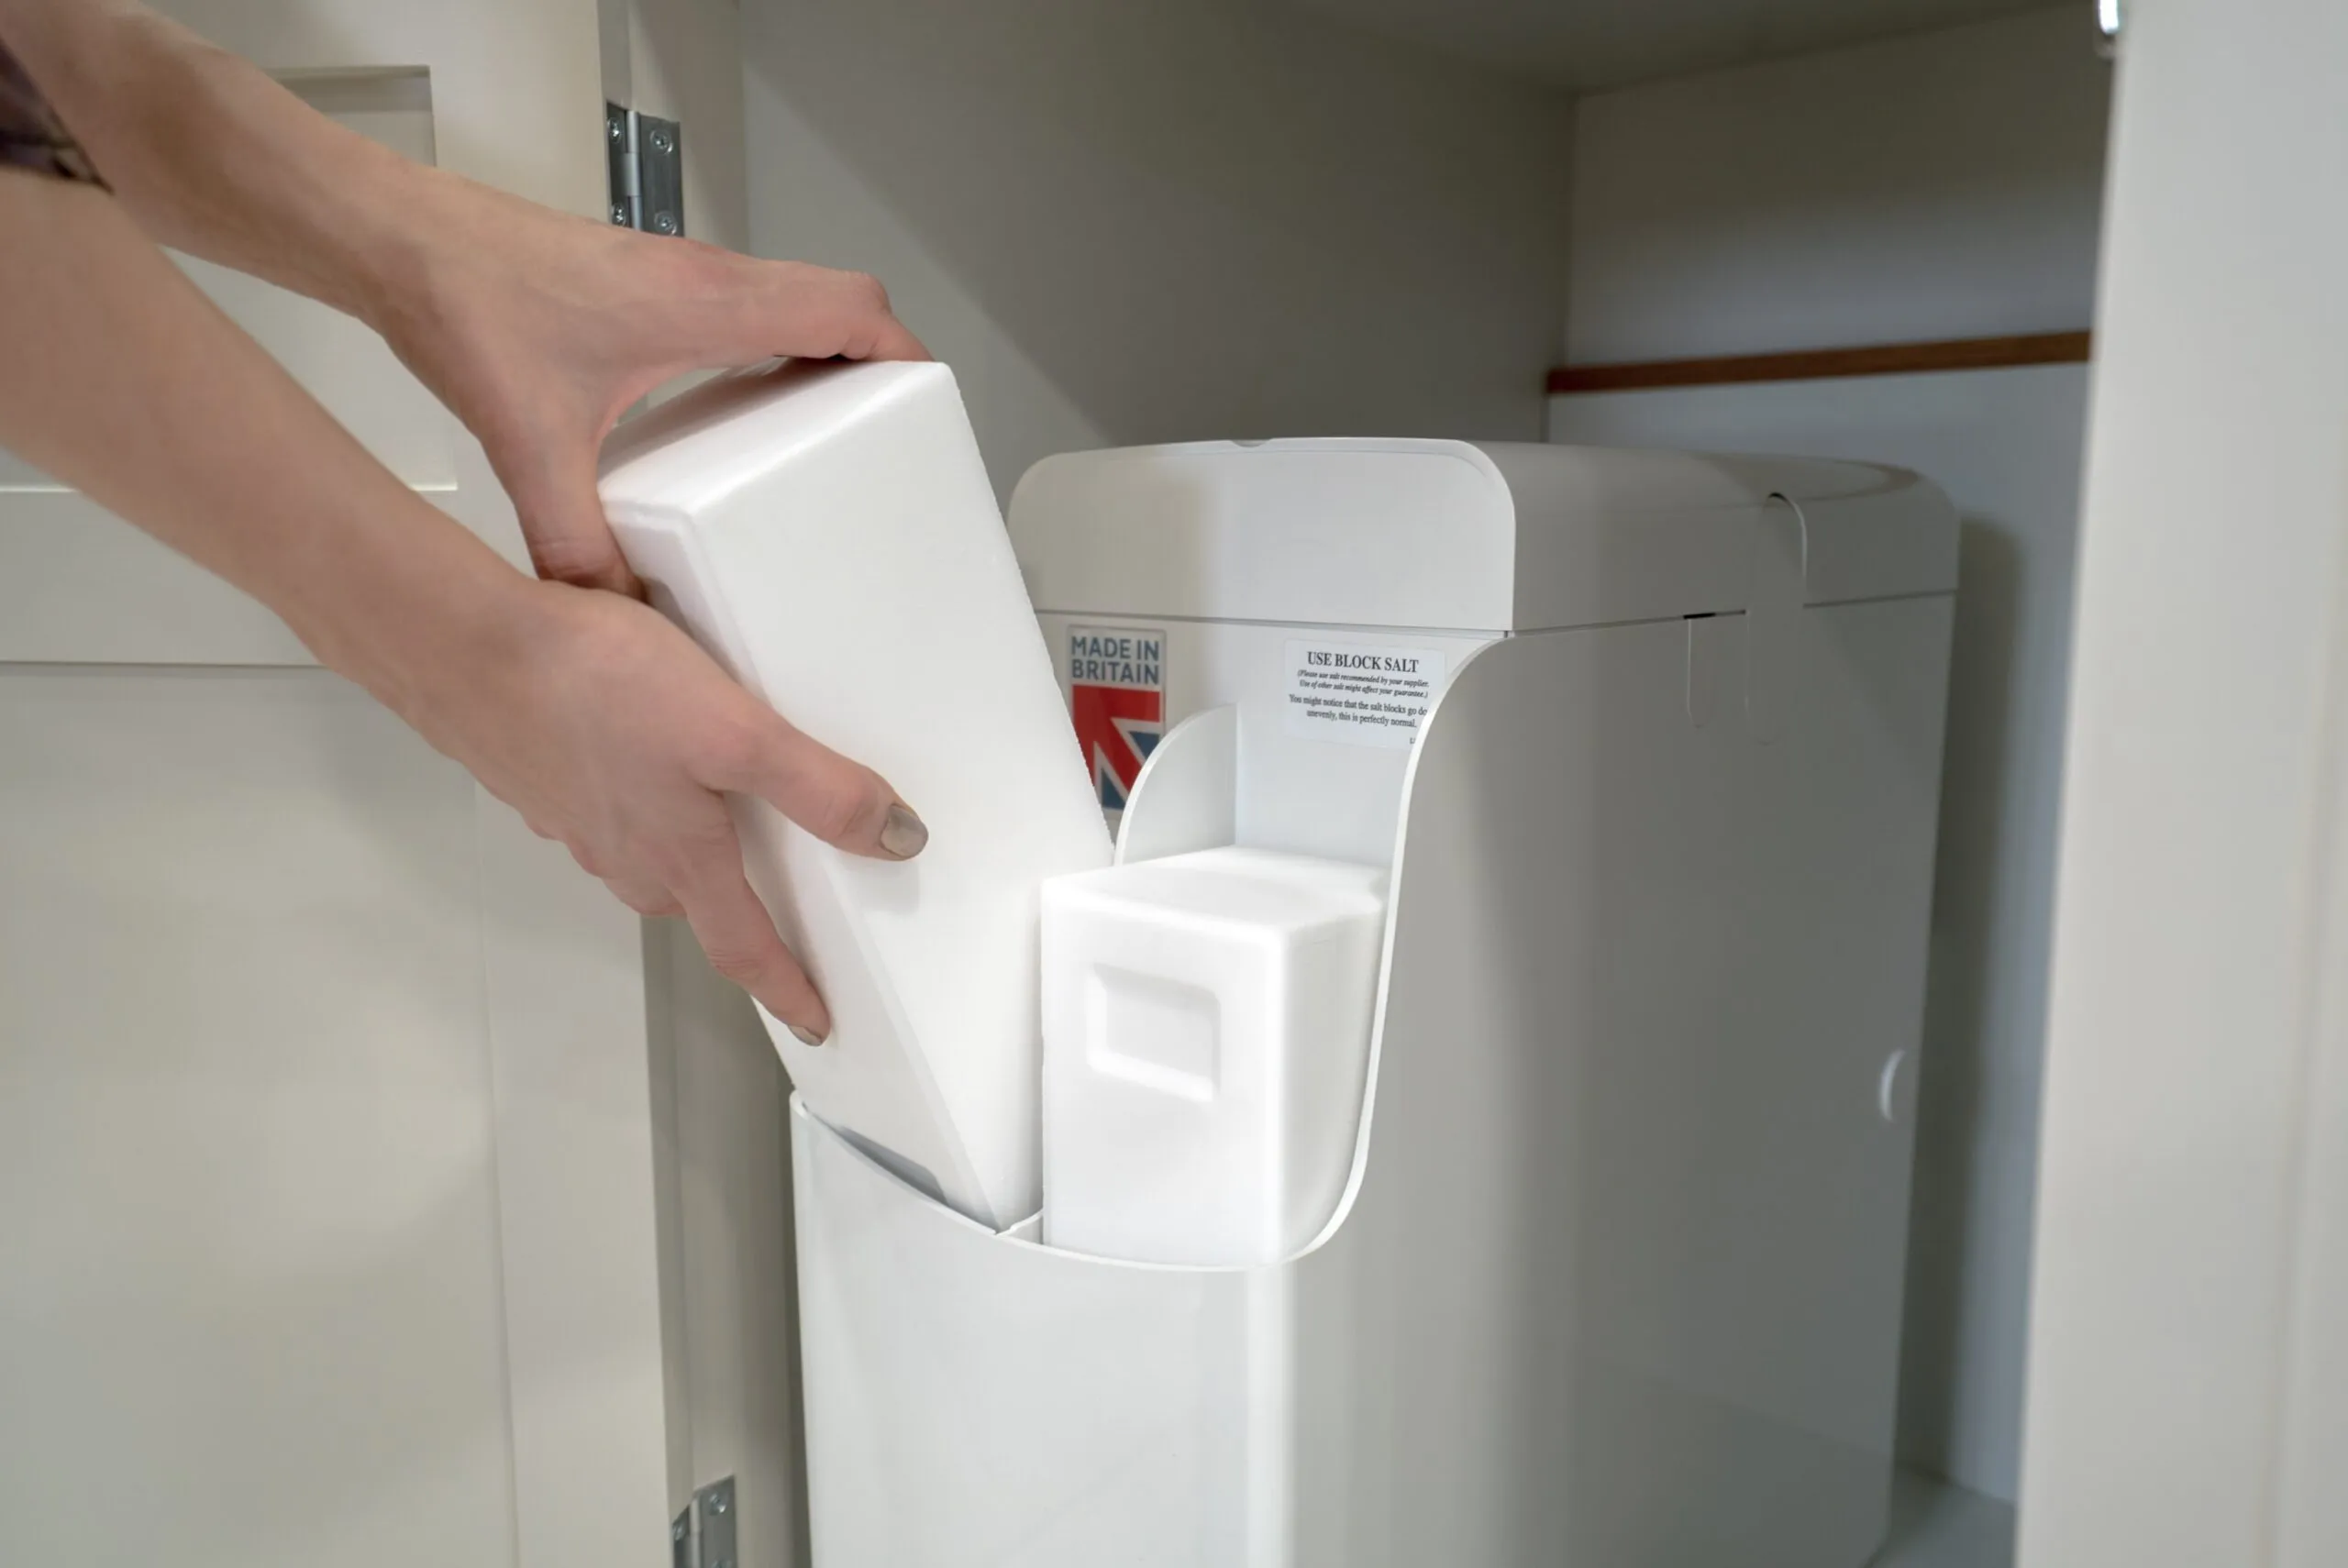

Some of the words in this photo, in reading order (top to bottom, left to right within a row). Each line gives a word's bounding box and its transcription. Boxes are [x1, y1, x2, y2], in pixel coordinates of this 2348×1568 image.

[1071, 635, 1131, 659] MADE
[1136, 639, 1159, 661] IN
[1071, 658, 1159, 685] BRITAIN
[1307, 651, 1332, 666] USE
[1335, 654, 1382, 670] BLOCK
[1384, 657, 1419, 673] SALT
[1311, 679, 1318, 689] of
[1345, 684, 1361, 692] might
[1362, 685, 1379, 694] affect
[1340, 674, 1379, 683] recommended
[1380, 676, 1388, 685] by
[1289, 693, 1301, 703] You
[1302, 695, 1322, 706] might
[1323, 698, 1343, 707] notice
[1344, 699, 1357, 709] that
[1358, 701, 1368, 710] the
[1370, 701, 1382, 712] salt
[1384, 703, 1406, 713] blocks
[1407, 707, 1417, 716] go
[1307, 710, 1337, 721] unevenly,
[1338, 711, 1351, 721] this
[1352, 712, 1358, 722] is
[1359, 714, 1390, 726] perfectly
[1390, 718, 1417, 728] normal.
